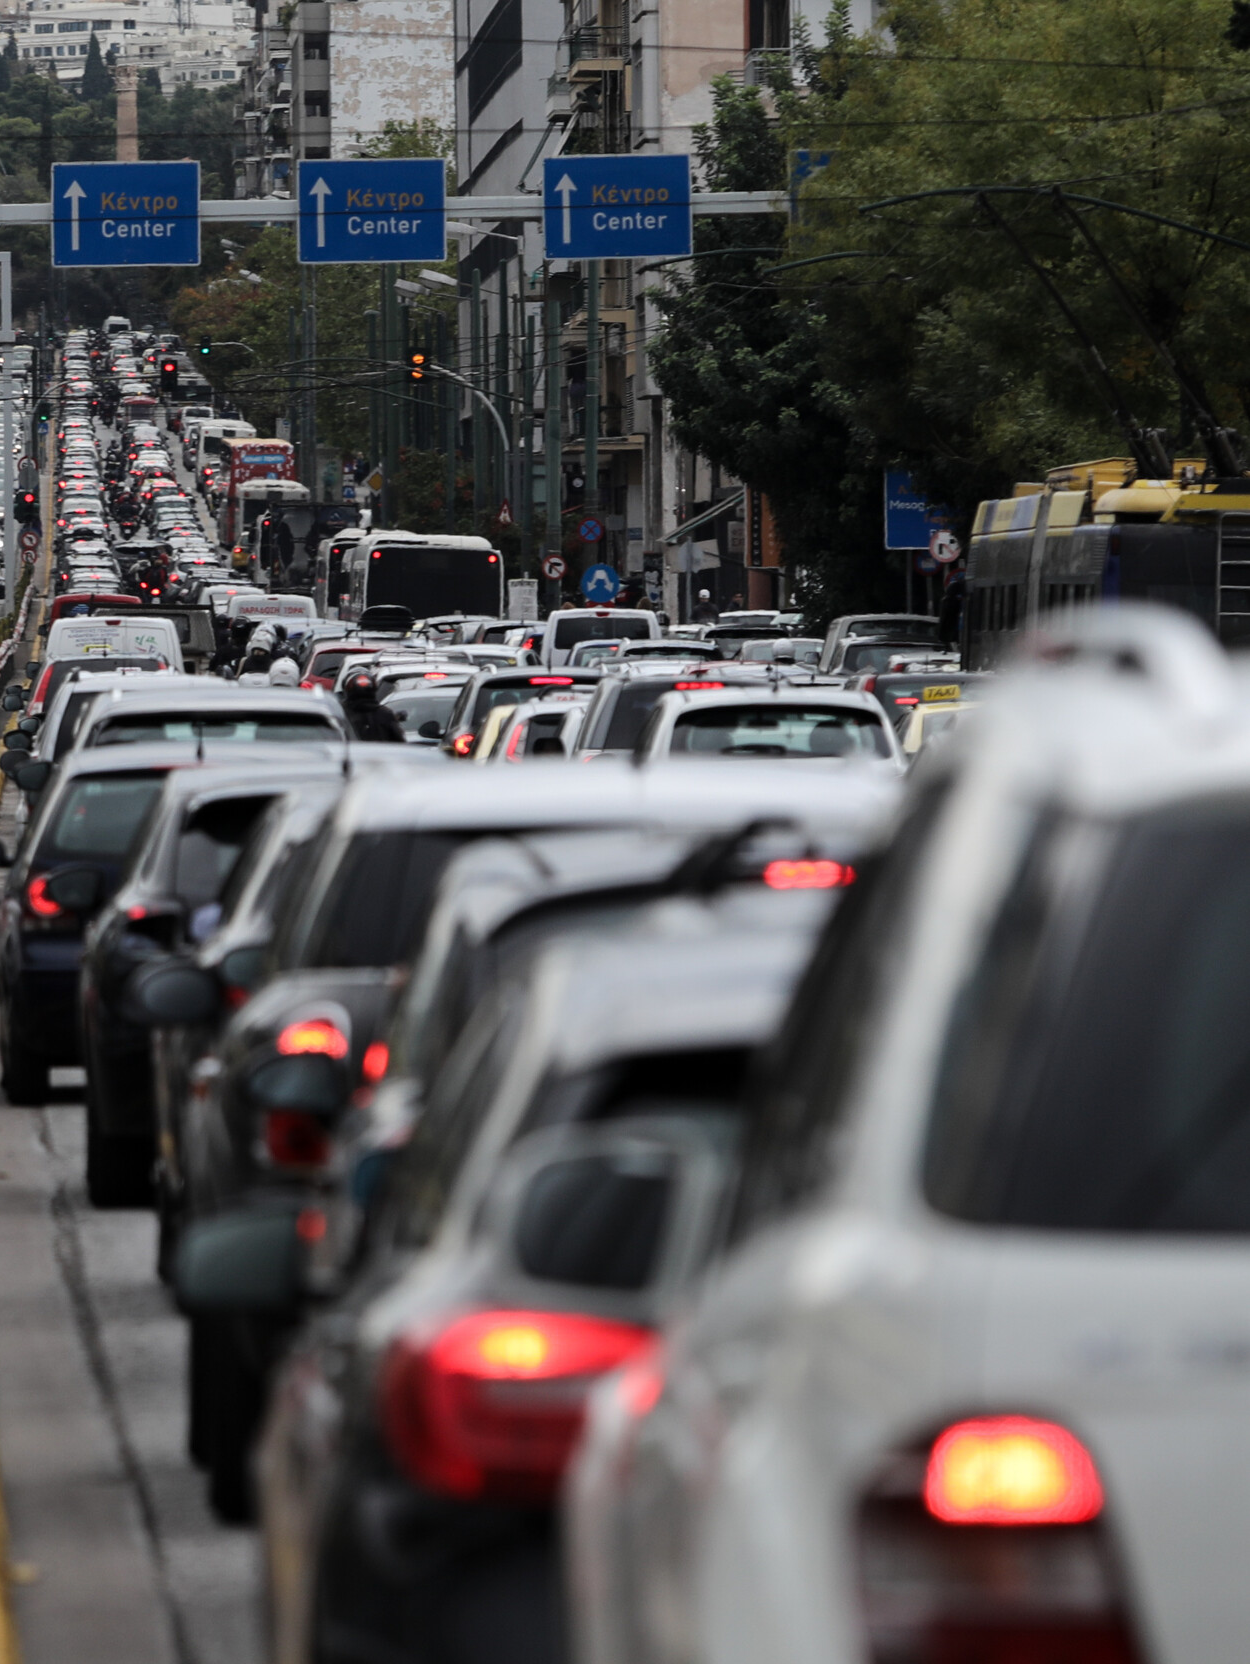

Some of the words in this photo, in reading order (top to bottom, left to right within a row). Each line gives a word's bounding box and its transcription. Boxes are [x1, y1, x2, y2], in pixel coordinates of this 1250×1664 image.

[101, 192, 178, 215] Κέντρο
[347, 189, 424, 211] Κέντρο
[592, 185, 669, 206] Κέντρο
[101, 219, 176, 238] Center
[347, 216, 422, 235] Center
[592, 211, 668, 231] Center
[890, 500, 928, 511] Mesog
[927, 687, 957, 698] TAXI
